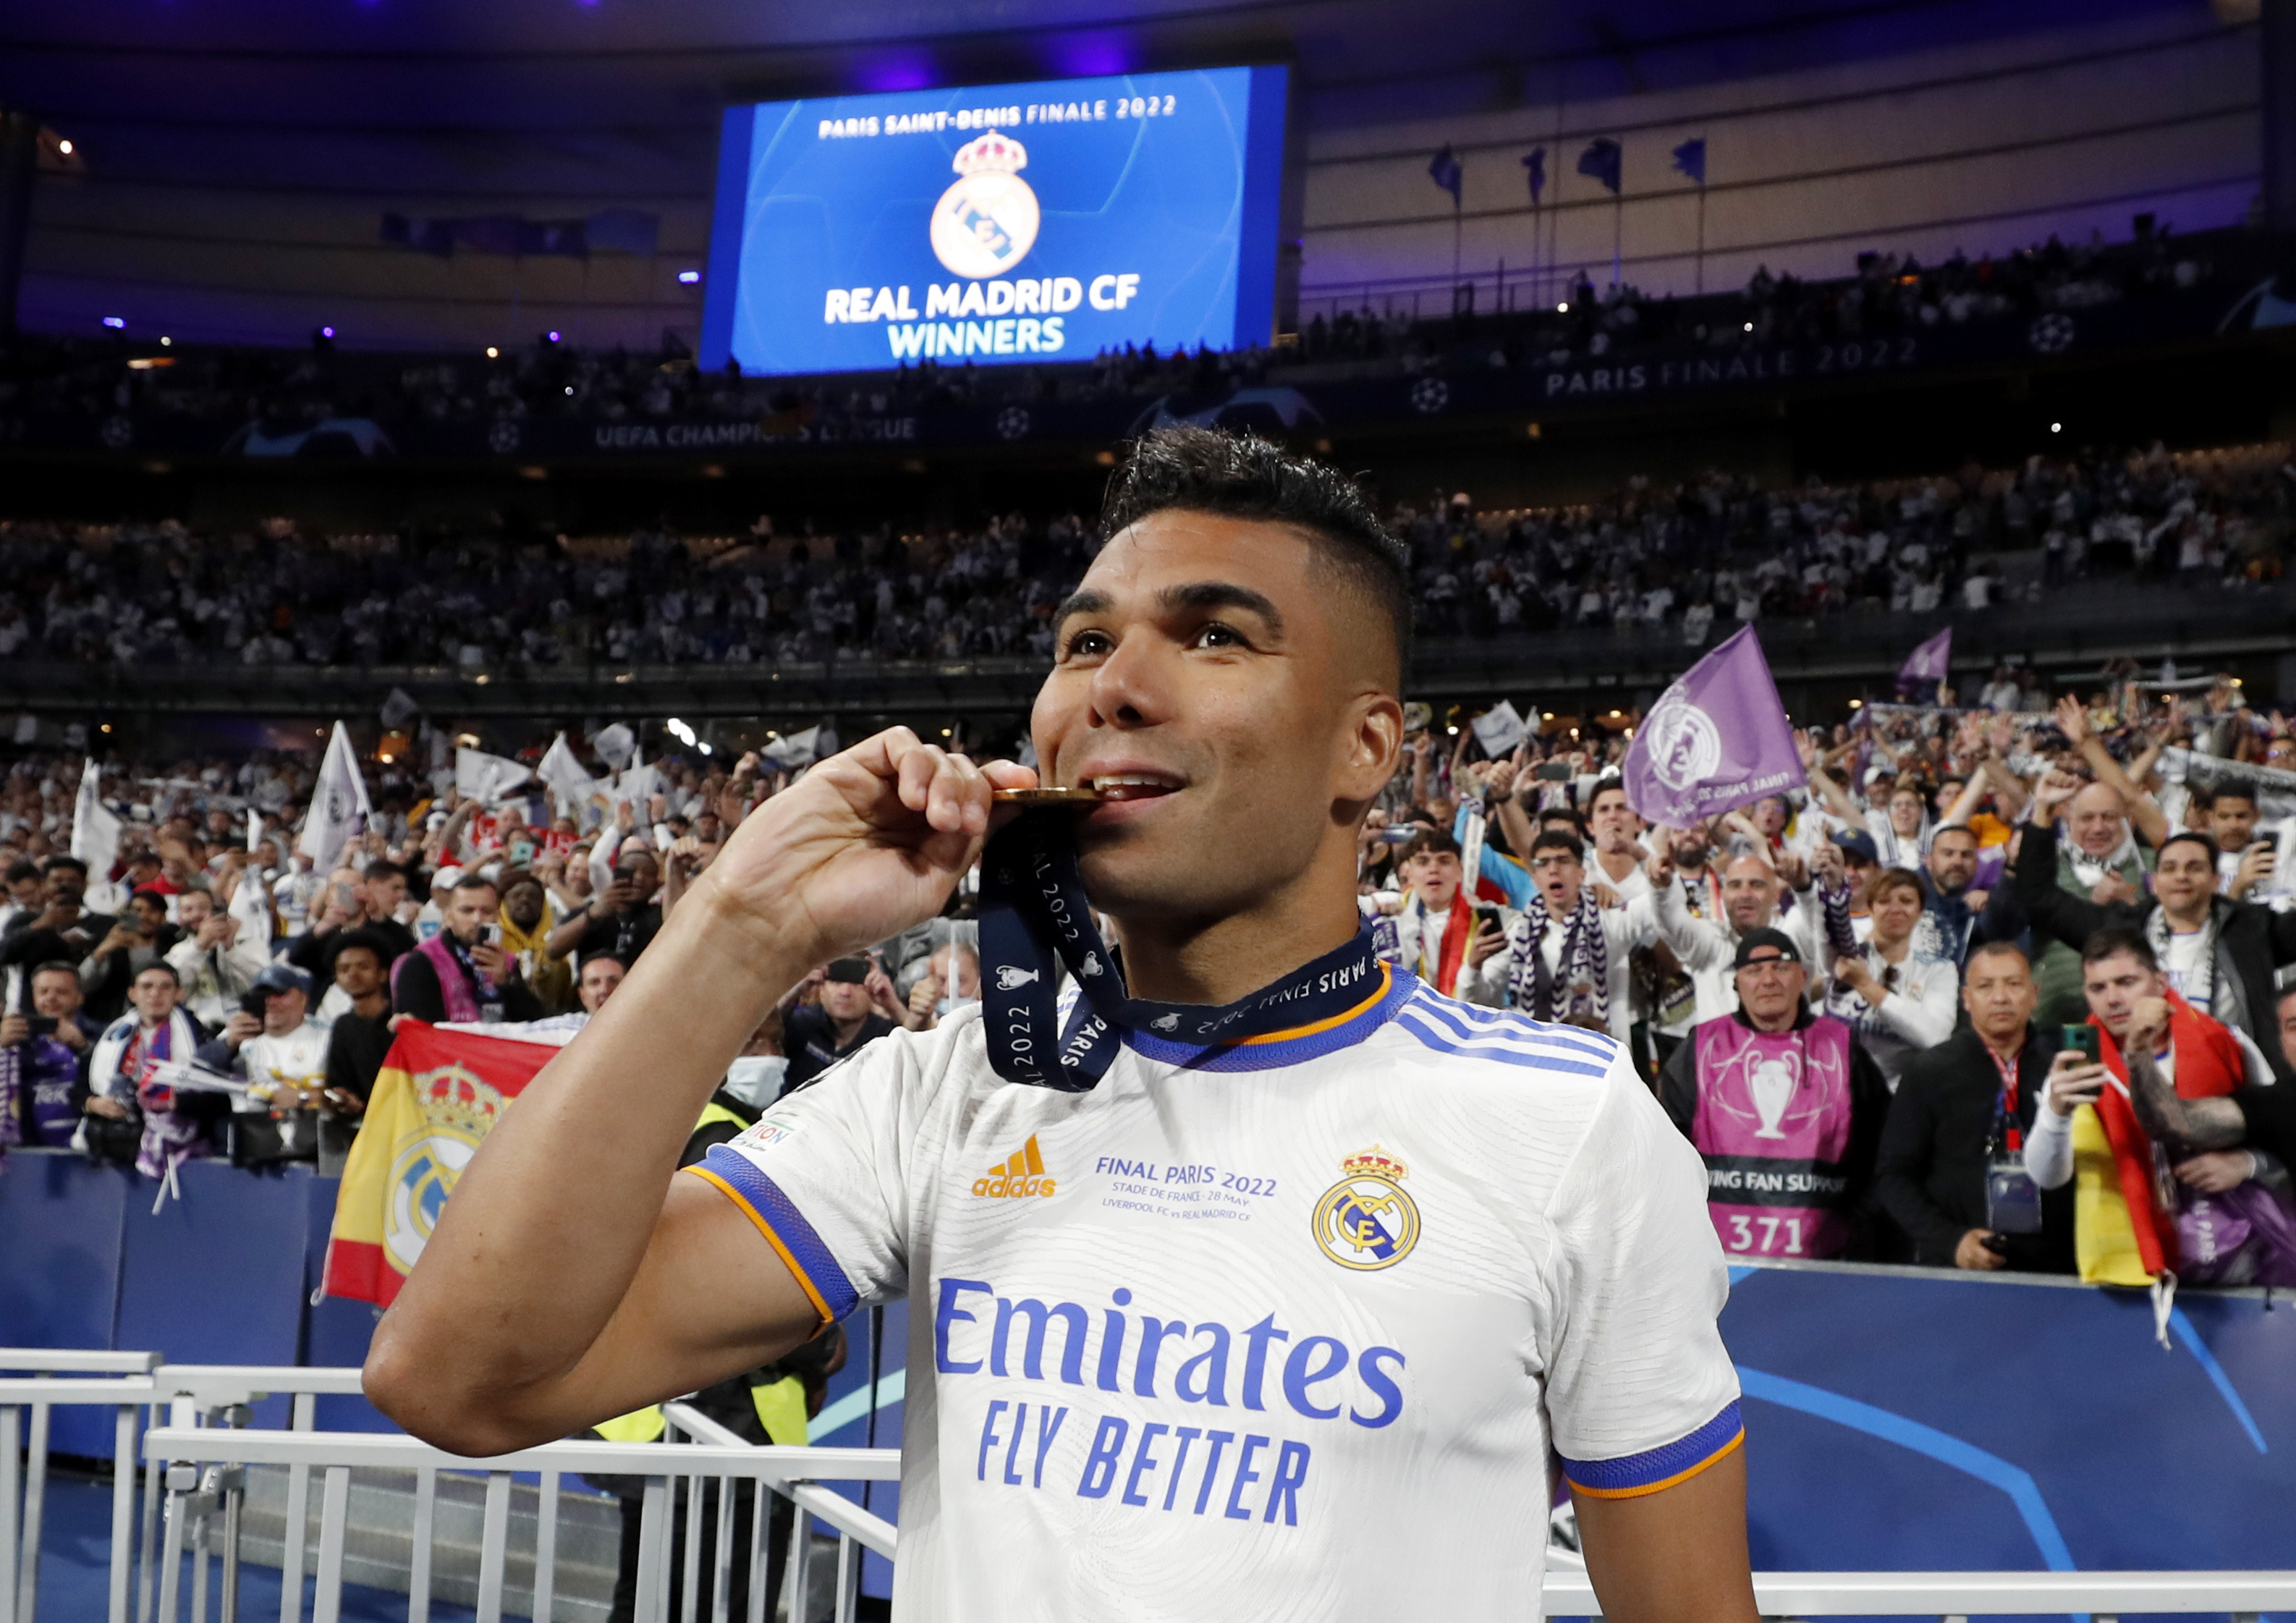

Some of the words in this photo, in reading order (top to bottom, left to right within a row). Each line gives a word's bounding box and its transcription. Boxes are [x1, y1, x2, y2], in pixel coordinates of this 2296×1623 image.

[818, 116, 880, 140] PARIS
[884, 106, 1021, 135] SAINT-DENIS
[1026, 99, 1107, 125] FINALE
[1116, 95, 1177, 118] 2022
[824, 285, 919, 324] REAL
[925, 276, 1083, 318] MADRID
[1088, 273, 1140, 311] CF
[887, 316, 1065, 359] WINNERS
[1546, 365, 1647, 397] PARIS
[1661, 349, 1795, 385] FINALE
[1816, 336, 1917, 372] 2022
[596, 425, 661, 447] UEFA
[666, 422, 810, 446] CHAMPIS
[1042, 883, 1079, 942] 2022
[1318, 957, 1366, 993] PARIS
[1008, 1006, 1034, 1066] 2022
[1060, 1014, 1108, 1067] PARIS
[747, 1123, 789, 1145] TION
[972, 1175, 1056, 1198] adidas
[1096, 1157, 1158, 1181] FINAL
[1164, 1165, 1216, 1185] PARIS
[1221, 1172, 1277, 1197] 2022
[1111, 1182, 1148, 1195] STADE
[1150, 1187, 1166, 1200] DE
[1166, 1191, 1201, 1202] FRANCE
[1206, 1190, 1221, 1201] 28
[1223, 1194, 1250, 1207] MAY
[1745, 1171, 1784, 1192] FAN
[1102, 1198, 1154, 1213] LIVERPOOL
[1156, 1206, 1169, 1217] FC
[1182, 1209, 1201, 1219] REAL
[1201, 1208, 1237, 1219] MADRID
[1238, 1212, 1252, 1221] CF
[1729, 1214, 1803, 1255] 371
[935, 1278, 1407, 1429] Emirates
[978, 1399, 1069, 1490] FLY
[1077, 1415, 1312, 1527] BETTER
